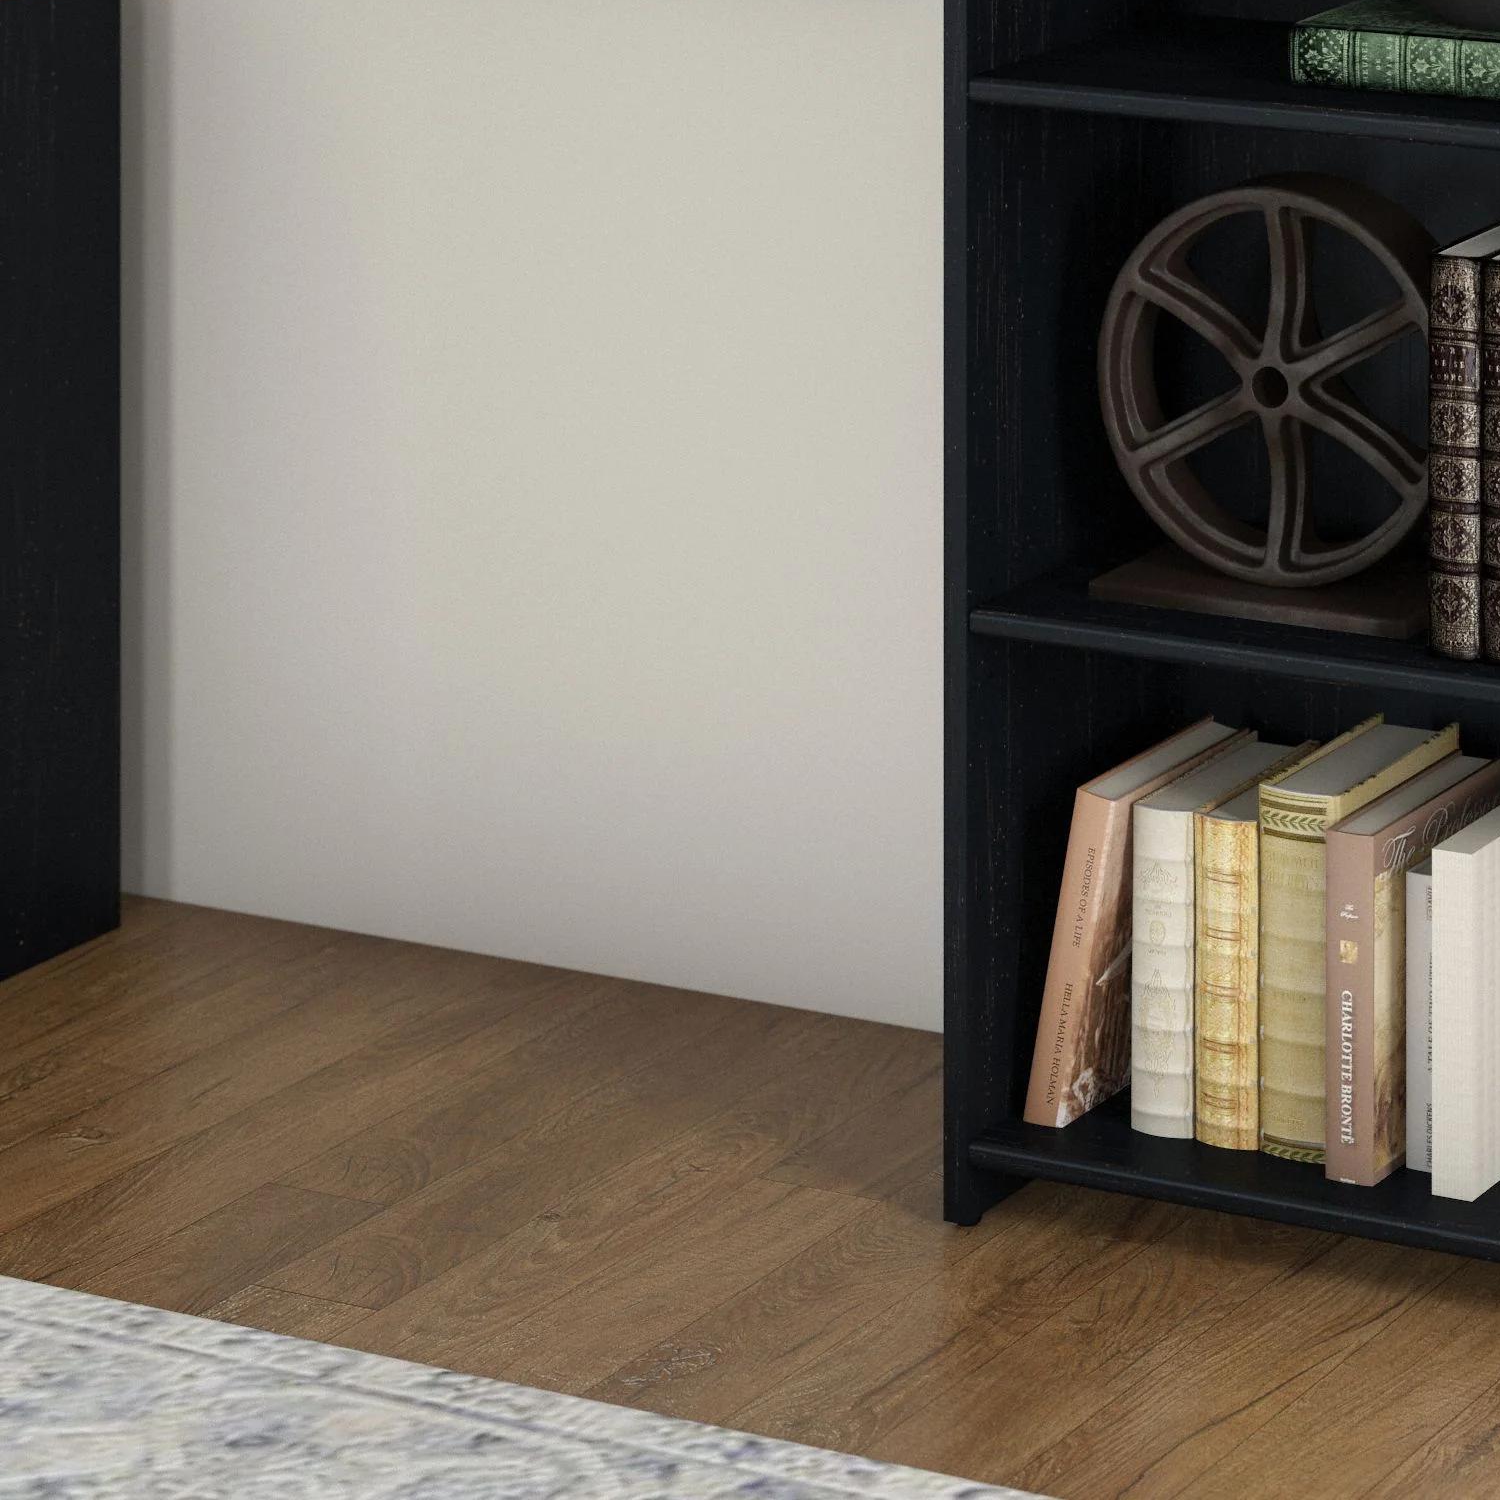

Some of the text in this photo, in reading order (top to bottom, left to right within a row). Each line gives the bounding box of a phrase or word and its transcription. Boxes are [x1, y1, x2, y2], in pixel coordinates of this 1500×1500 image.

[1072, 846, 1096, 949] EPISODES OF A LIFE
[1046, 982, 1073, 1106] HELLA MARIA HOLMAN
[1340, 990, 1355, 1145] CHARLOTTE BRONTË
